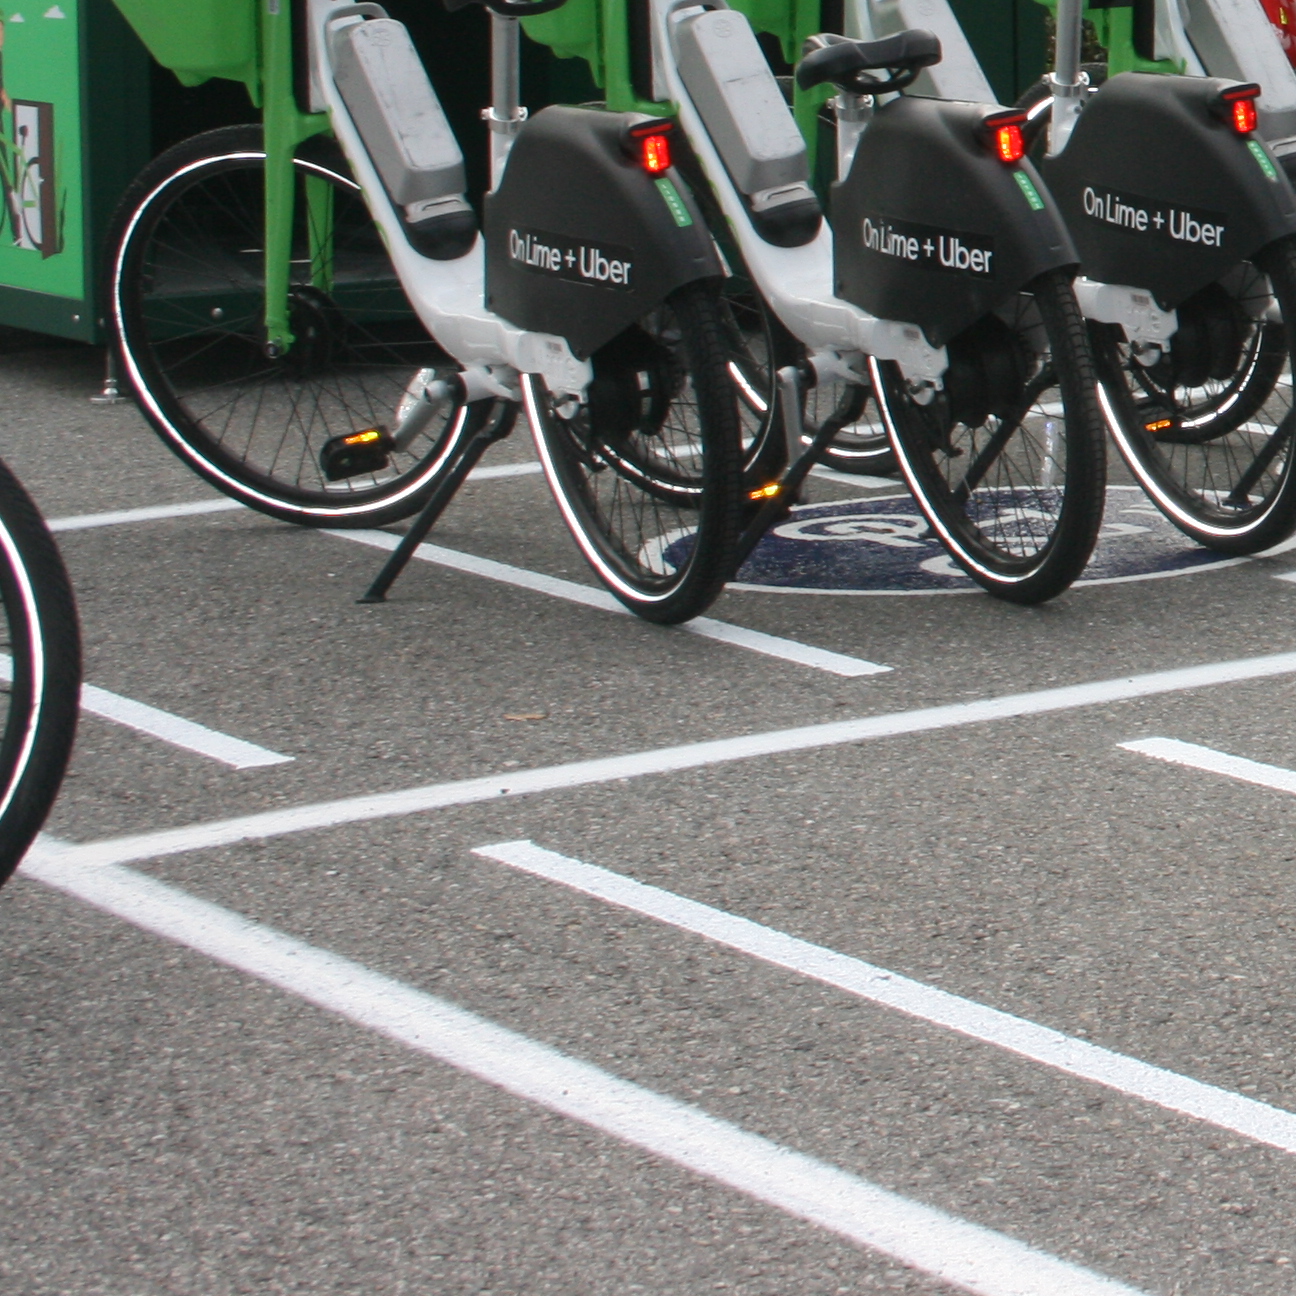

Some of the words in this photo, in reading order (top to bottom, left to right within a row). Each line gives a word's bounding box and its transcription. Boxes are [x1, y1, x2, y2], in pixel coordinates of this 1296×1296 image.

[862, 216, 880, 250] On
[880, 218, 919, 261] Lime
[922, 238, 936, 258] +
[938, 235, 993, 274] Uber
[1082, 185, 1105, 219] On
[1105, 189, 1148, 232] Lime
[1152, 211, 1166, 231] +
[1169, 211, 1225, 248] Uber
[508, 228, 526, 262] On
[525, 235, 562, 272] Lime
[563, 250, 578, 269] +
[579, 247, 632, 285] Uber
